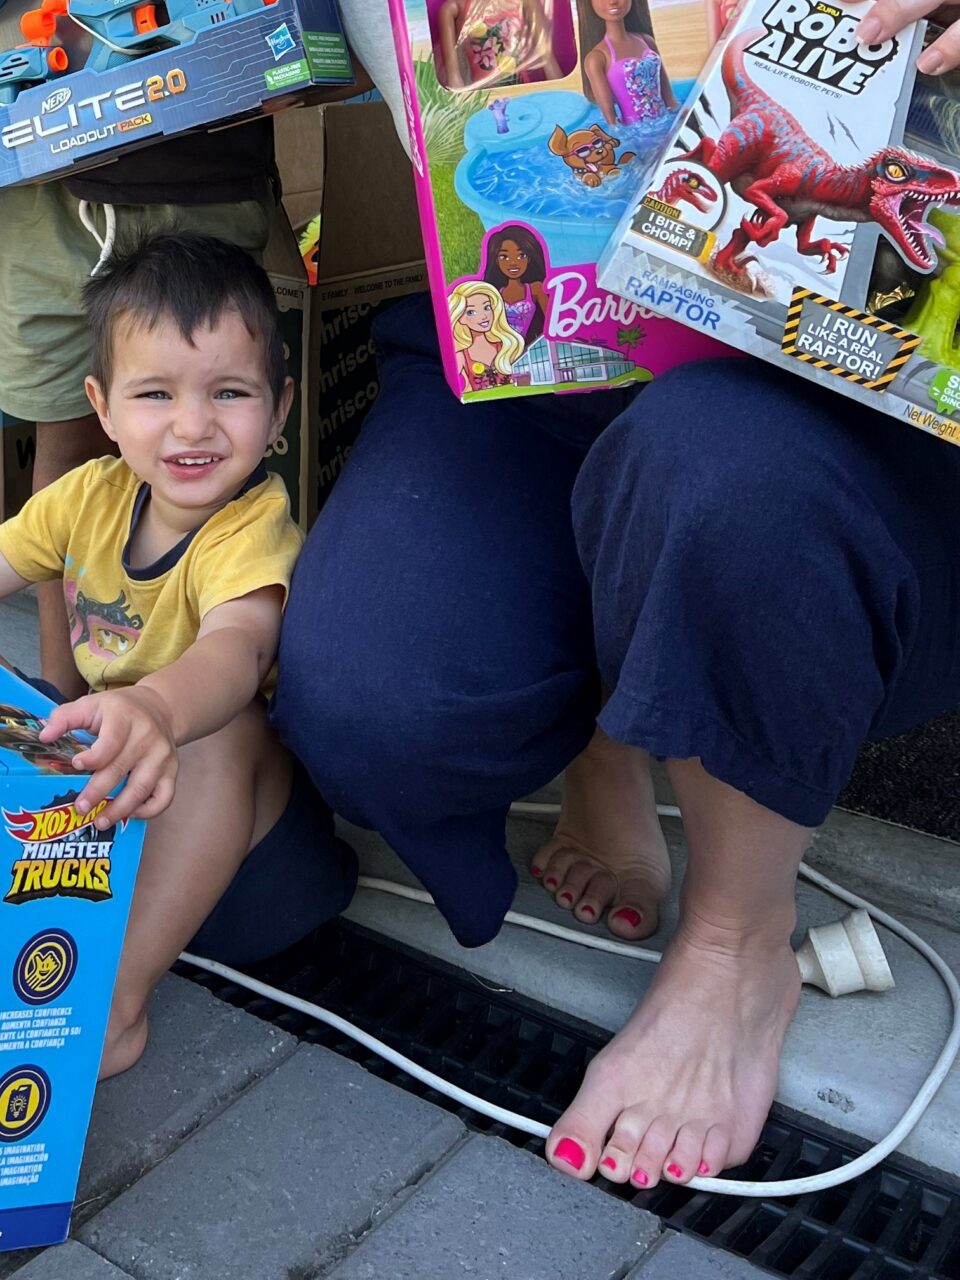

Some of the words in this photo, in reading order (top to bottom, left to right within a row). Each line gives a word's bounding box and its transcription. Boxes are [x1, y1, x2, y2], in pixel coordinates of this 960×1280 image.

[816, 2, 840, 18] ZURU
[747, 27, 877, 94] ALIVE
[753, 60, 789, 79] REAL-LIFE
[789, 73, 822, 92] ROBOTIC
[820, 85, 844, 100] PETS!
[1, 79, 146, 149] ELITE
[145, 67, 187, 103] 2.0
[41, 86, 72, 116] NERF
[50, 123, 117, 155] LOADOUT
[120, 113, 151, 131] PACK
[643, 196, 681, 219] CAUTION
[641, 222, 693, 252] CHOMP!
[655, 215, 687, 235] BITE
[327, 288, 349, 300] FAMILY
[354, 281, 385, 294] WELCOME
[393, 277, 404, 287] THE
[405, 273, 425, 285] FAMILY
[642, 270, 716, 309] RAMPAGING
[624, 275, 722, 331] RAPTOR
[807, 322, 838, 344] LIKE
[849, 340, 885, 366] REAL
[832, 316, 878, 349] RUN
[797, 333, 882, 380] RAPTOR!
[903, 403, 923, 422] Net
[922, 413, 958, 439] Weight
[27, 809, 71, 841] HOT
[21, 841, 114, 860] MONSTER
[5, 858, 112, 899] TRUCKS
[0, 1009, 34, 1021] INCREASES
[34, 1006, 73, 1018] CONFIDENCE
[1, 1019, 31, 1031] AUMENTA
[31, 1017, 67, 1029] CONFIANZA
[25, 1028, 61, 1040] CONFIANCE
[70, 1026, 82, 1036] SOI
[30, 1037, 65, 1049] CONFIANÇA
[3, 1142, 46, 1155] IMAGINATION
[6, 1152, 49, 1166] IMAGINACIÓN
[0, 1172, 40, 1187] IMAGINAÇÃO
